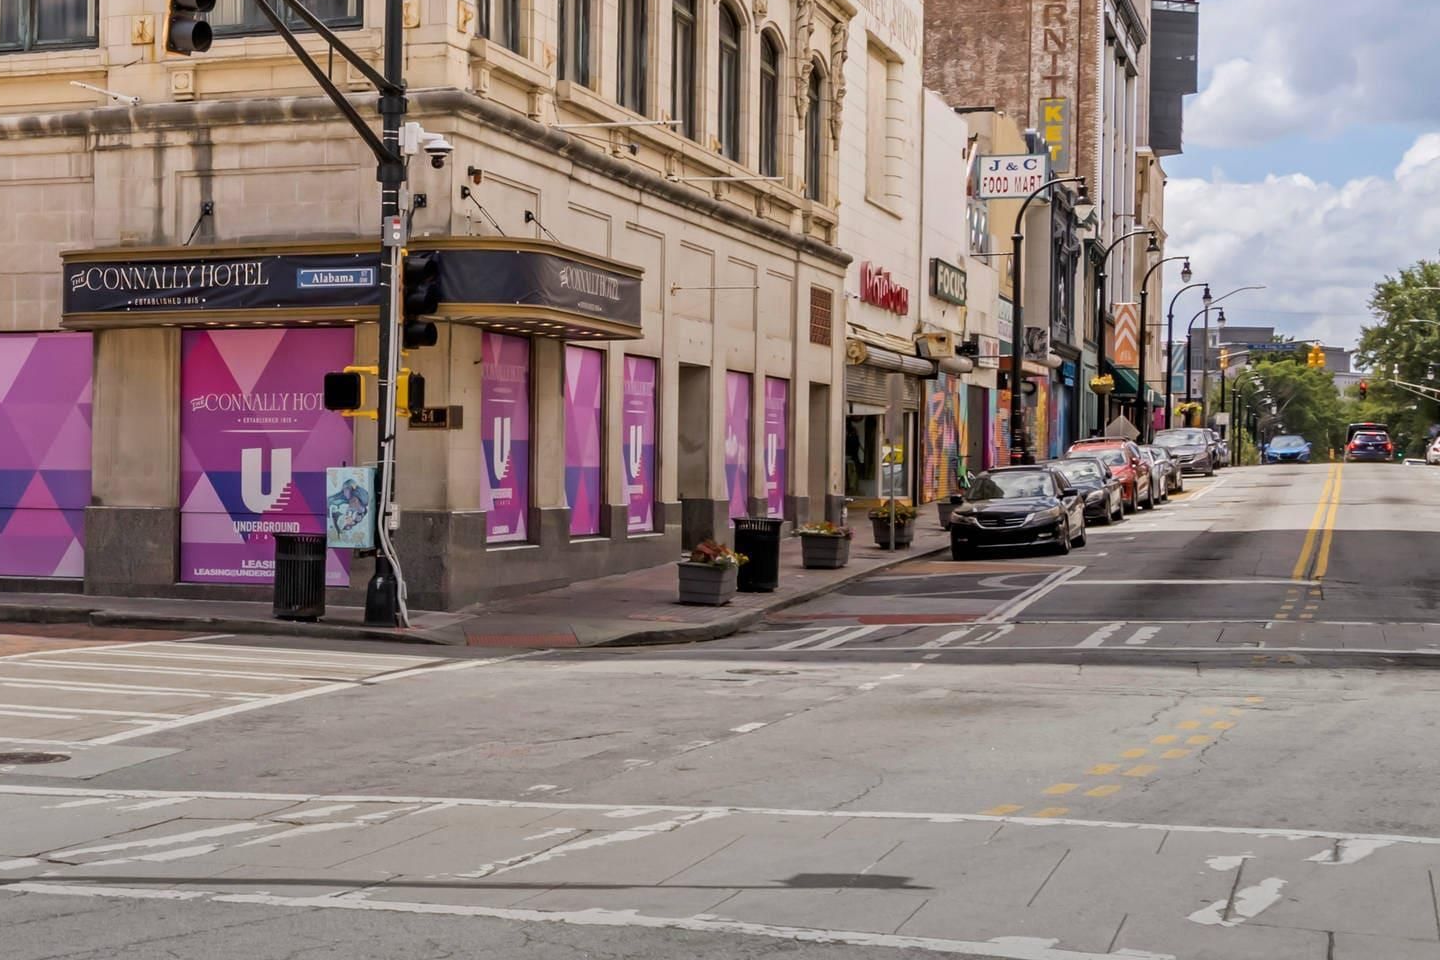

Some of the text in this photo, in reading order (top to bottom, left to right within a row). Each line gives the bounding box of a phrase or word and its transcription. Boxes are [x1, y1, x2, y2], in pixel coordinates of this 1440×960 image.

[989, 158, 1037, 171] J & C
[982, 175, 1042, 193] FOOD MART
[86, 265, 196, 291] CONNALLY
[200, 262, 269, 288] HOTEL
[312, 272, 354, 284] Alabama
[937, 265, 965, 302] FOCUS
[134, 297, 182, 306] ESTABLISHED
[205, 392, 290, 412] CONNALLY
[293, 392, 324, 411] HOT
[422, 409, 434, 421] 54
[233, 520, 300, 533] UNDERGROUND
[241, 559, 275, 569] LEASI
